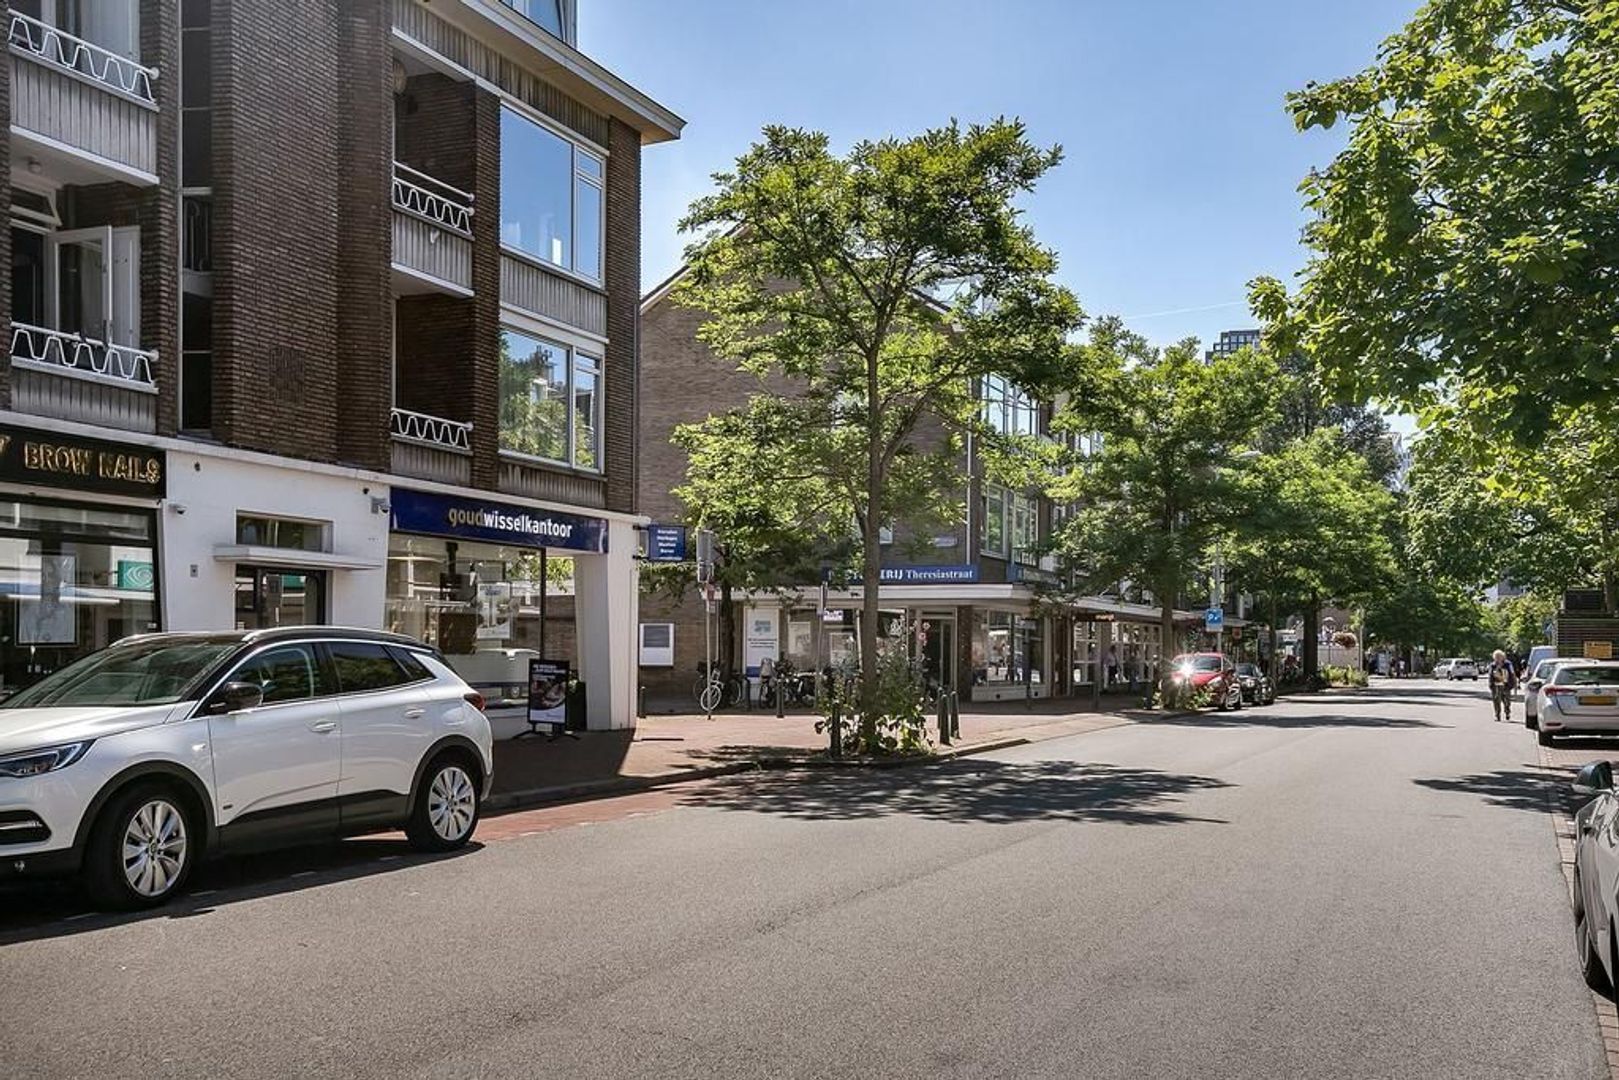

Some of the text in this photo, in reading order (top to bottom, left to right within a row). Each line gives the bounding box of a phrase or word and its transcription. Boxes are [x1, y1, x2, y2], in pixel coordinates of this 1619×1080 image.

[24, 441, 92, 476] BROW
[99, 451, 161, 484] NAILS
[449, 506, 573, 538] goudwisselkantoor
[906, 568, 973, 580] Theresiastraat
